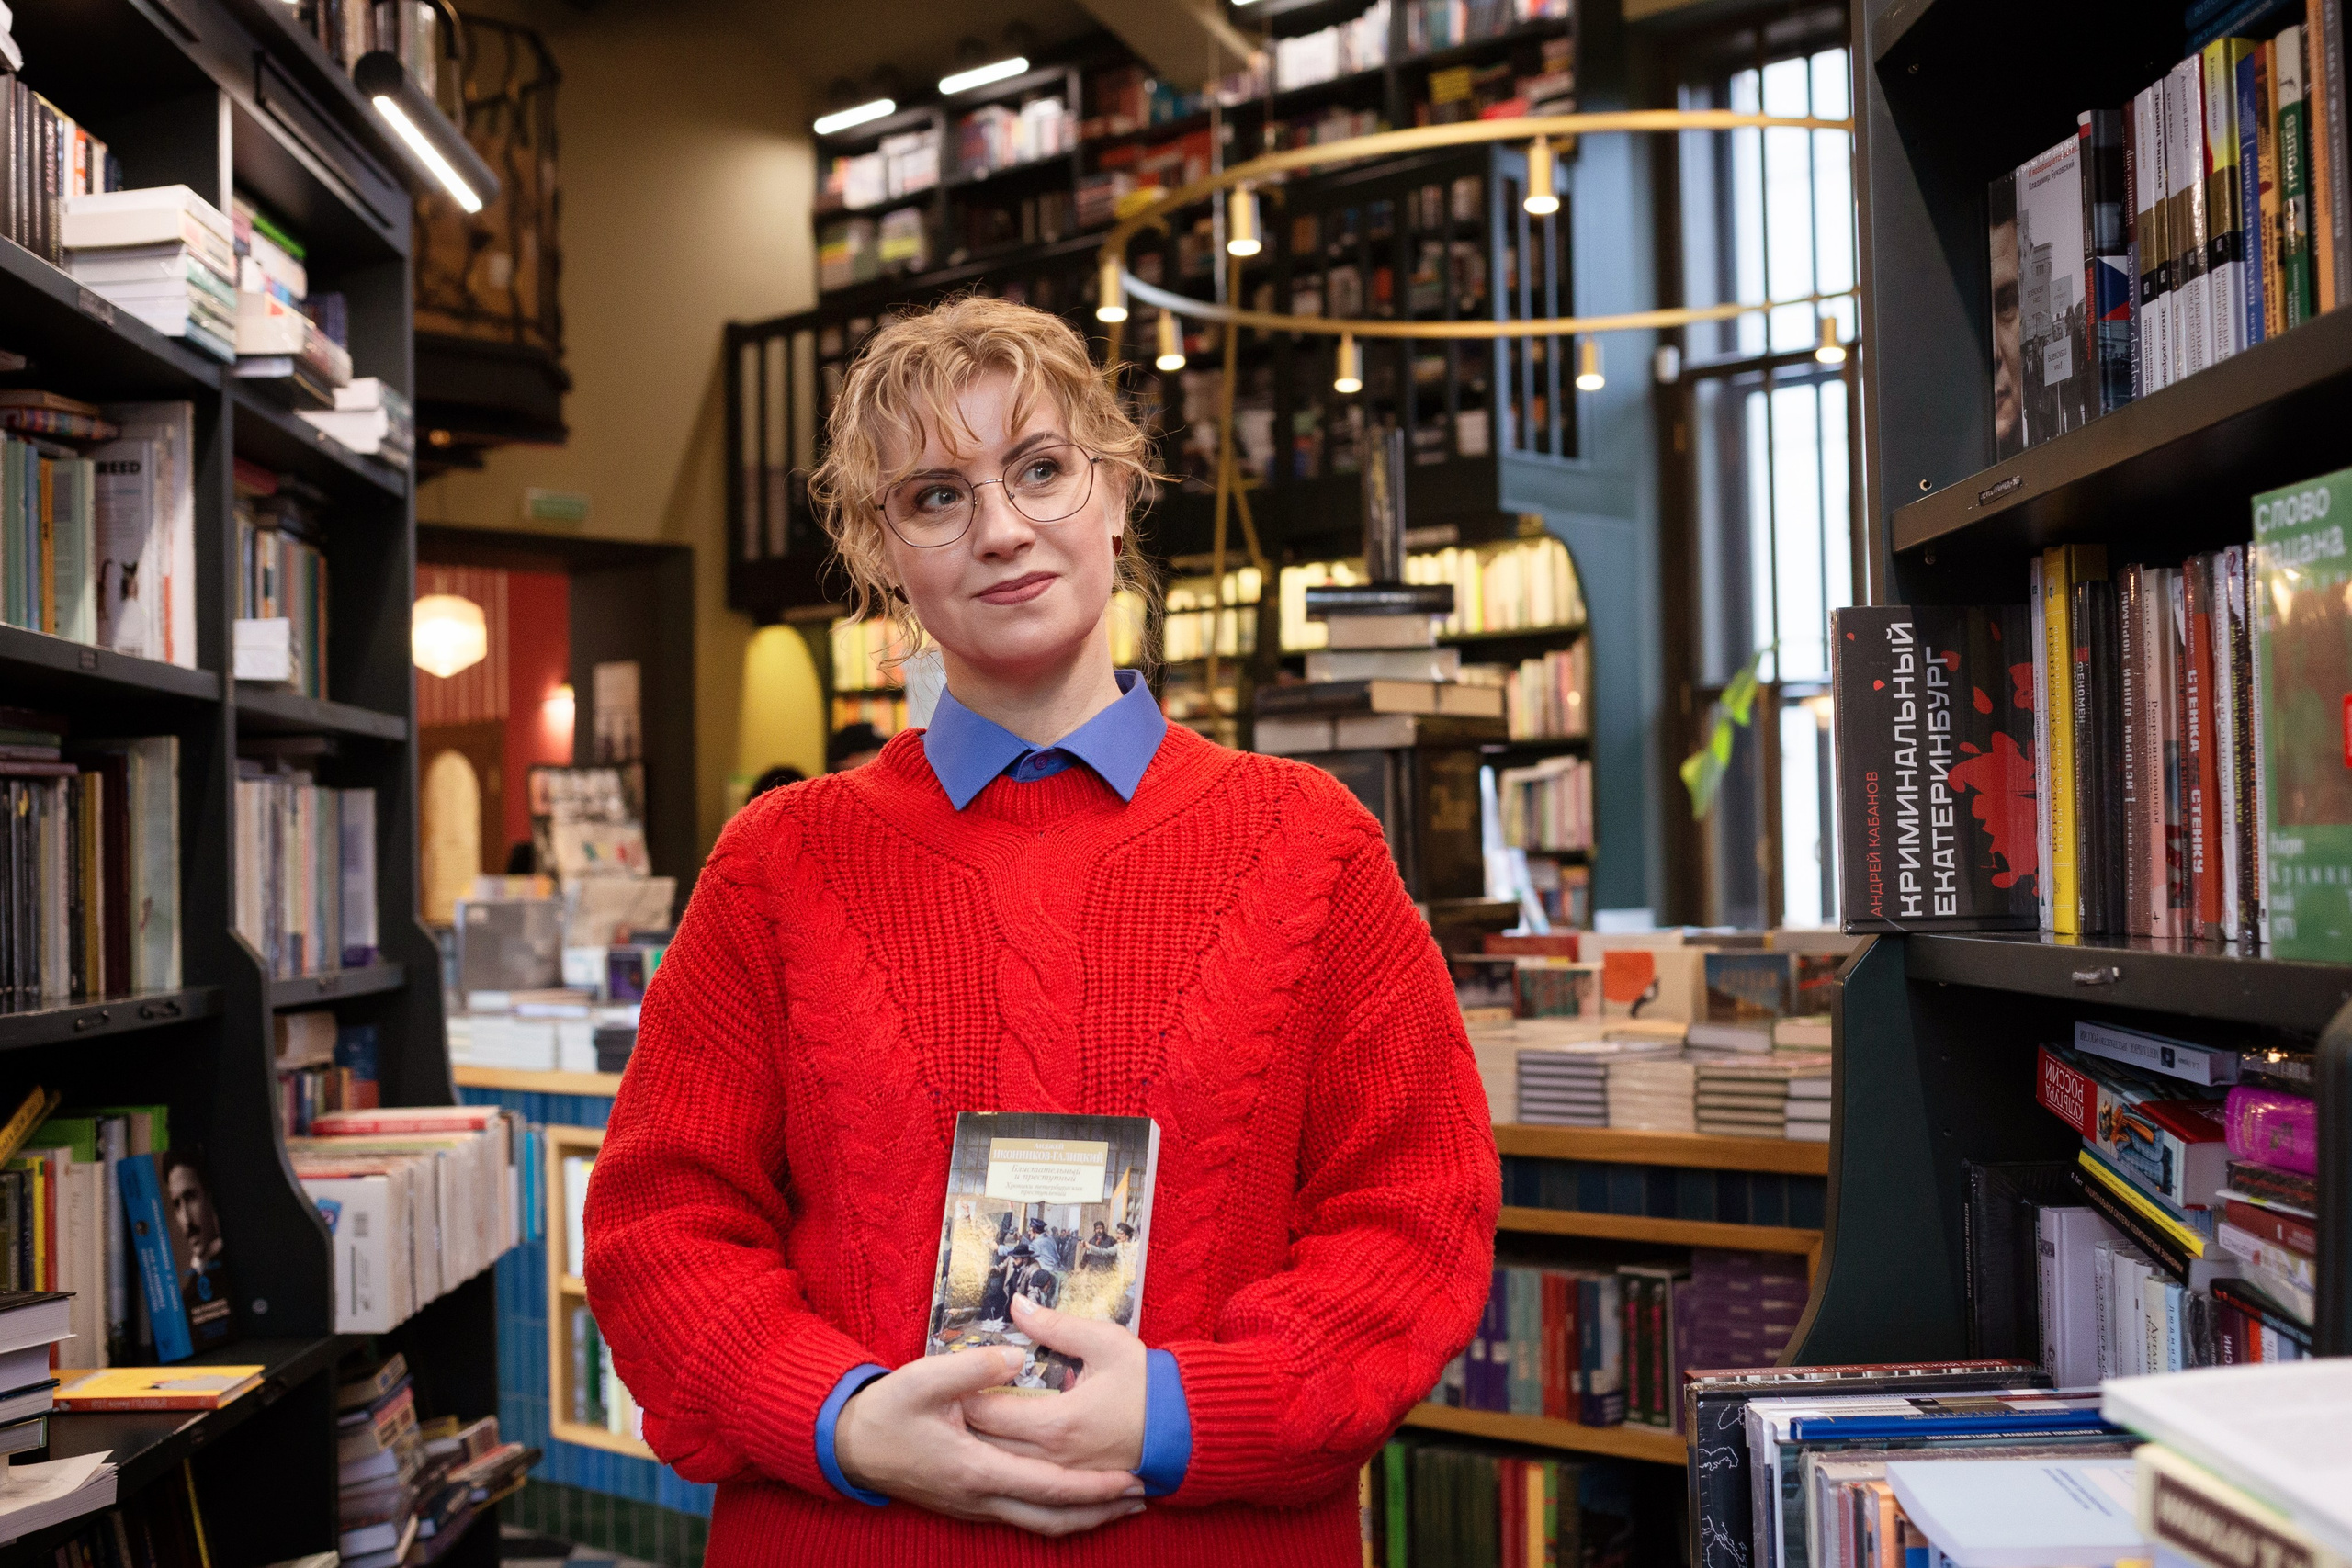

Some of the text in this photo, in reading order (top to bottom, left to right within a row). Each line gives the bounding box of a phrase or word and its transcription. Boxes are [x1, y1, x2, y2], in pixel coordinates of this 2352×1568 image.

[2049, 626, 2057, 752] КАРТЕЛЯМИ
[2076, 662, 2085, 723] ФЕНОМЕН
[2121, 592, 2133, 789] ИСТОРИИ ОДНОЙ ТЮРЬМЫ
[2188, 670, 2199, 752] СТЕНКА
[1886, 621, 1924, 918] КРИМИНАЛЬНЫЙ
[1926, 646, 1957, 917] ЕКАТЕРИНБУРГ
[2150, 700, 2160, 824] Реорганизованная
[1866, 770, 1883, 918] АНДРЕЙ КАБАНОВ
[2192, 789, 2203, 873] СТЕНКУ
[2045, 1060, 2084, 1103] РОССИИ
[2045, 1081, 2084, 1122] КУЛЬТУРА
[993, 1149, 1103, 1164] ИКОННИКОВ-ГАЛИЦКИЙ
[1011, 1164, 1081, 1175] Блистательный
[1023, 1174, 1077, 1182] преступный
[1883, 1361, 1962, 1371] СОВЕТСКИЙ
